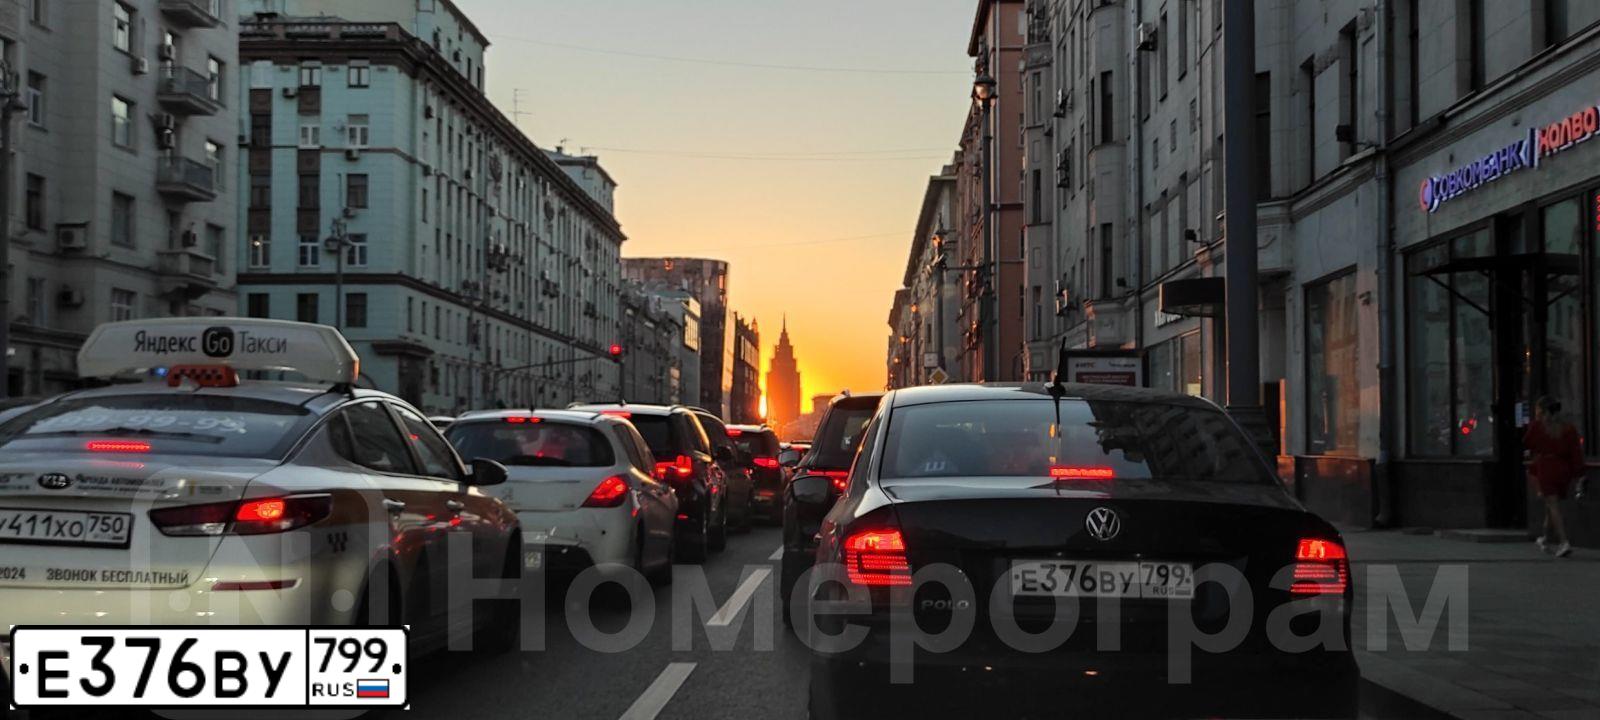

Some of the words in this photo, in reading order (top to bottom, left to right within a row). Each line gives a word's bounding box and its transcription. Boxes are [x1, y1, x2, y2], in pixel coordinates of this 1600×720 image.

[134, 330, 196, 354] Яндекс
[206, 330, 230, 351] Go
[239, 331, 287, 353] Такси
[89, 515, 124, 533] 750
[46, 568, 97, 582] ЗВОНОК
[101, 568, 190, 585] БЕСПЛАТНЫЙ
[1021, 563, 1135, 594] Е376ВУ
[1141, 563, 1186, 587] 799
[921, 599, 970, 610] POLO
